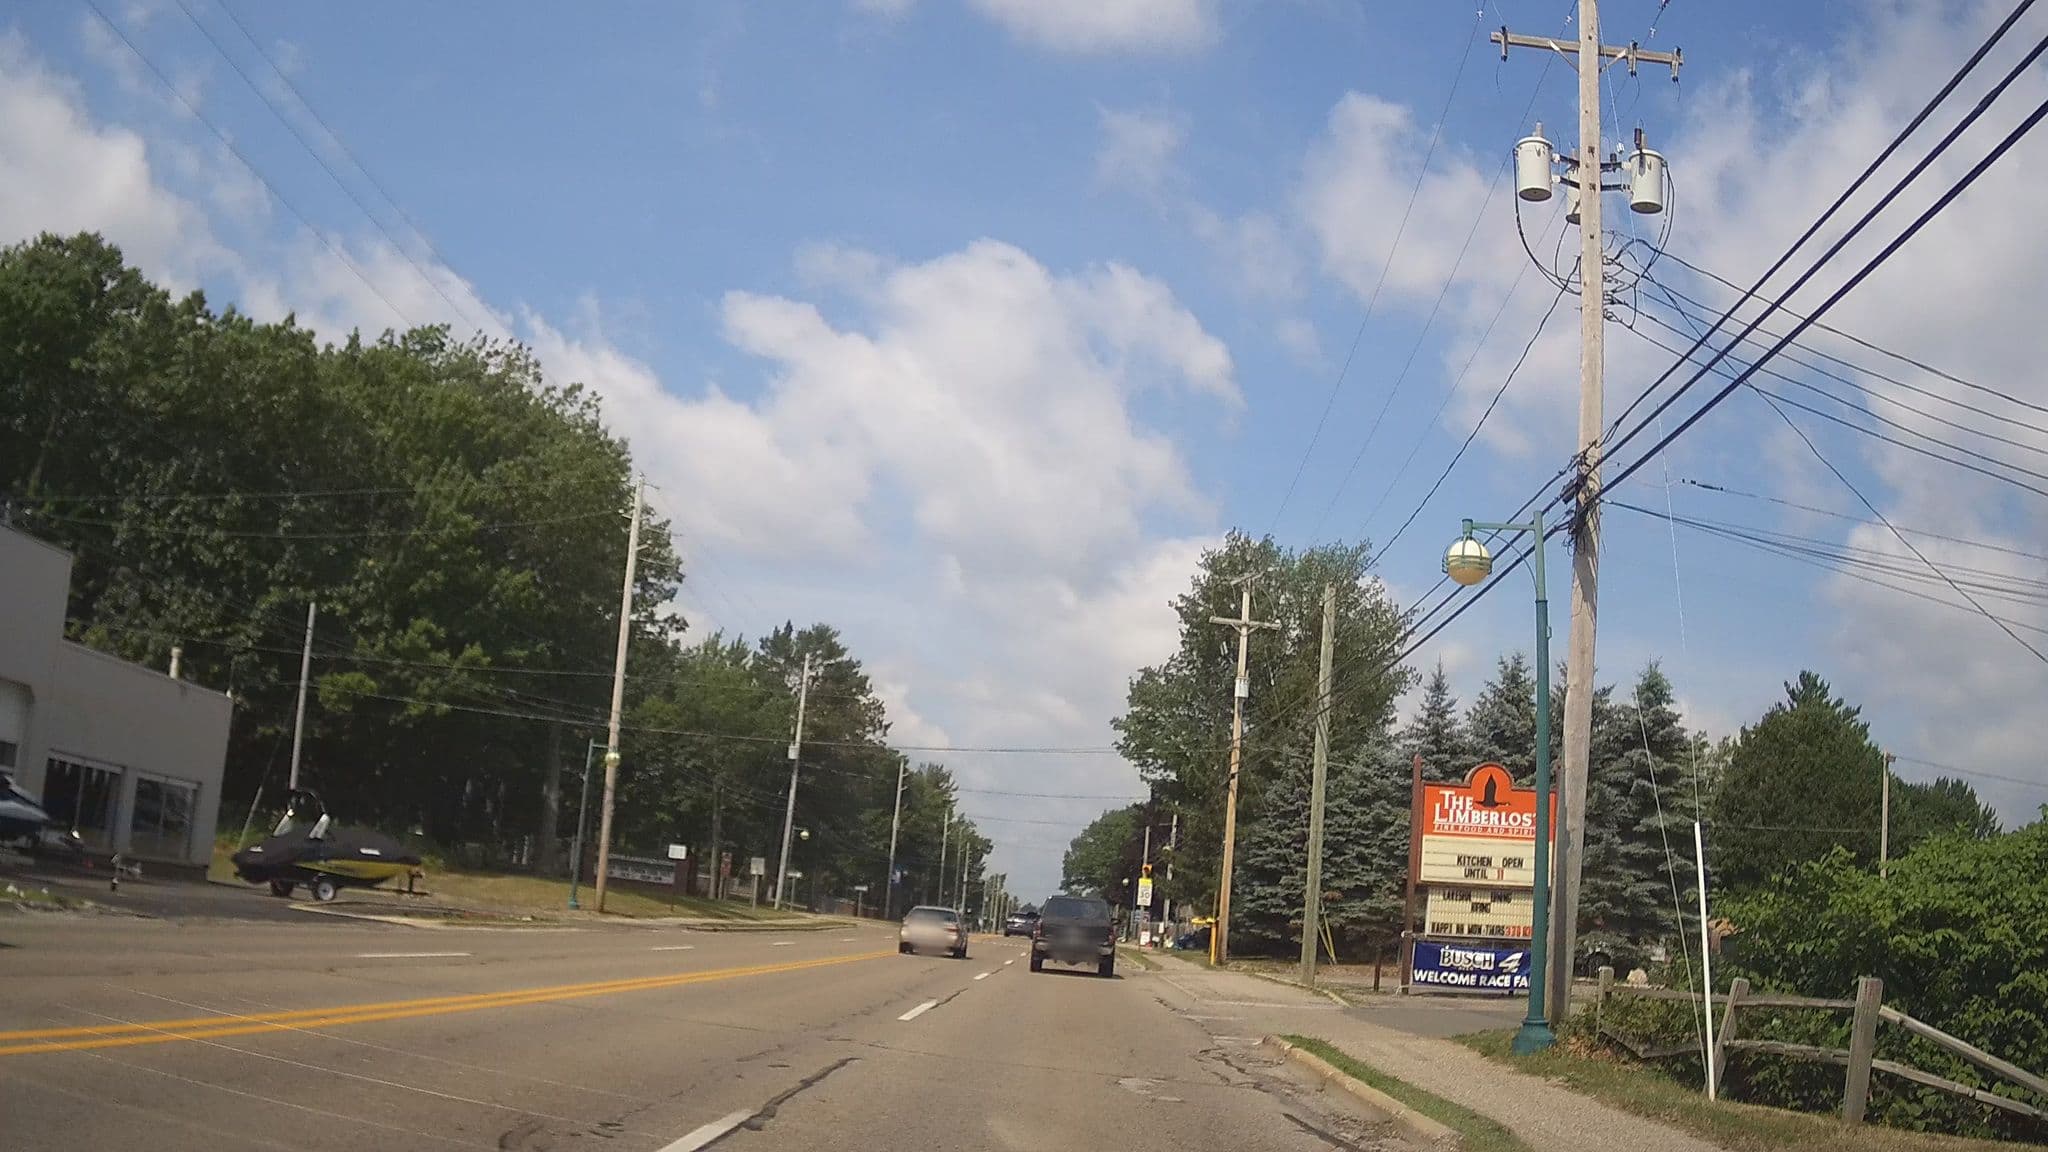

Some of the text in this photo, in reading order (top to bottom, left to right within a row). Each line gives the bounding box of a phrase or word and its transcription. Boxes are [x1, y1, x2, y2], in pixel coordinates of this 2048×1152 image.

[1439, 789, 1474, 811] THE
[1432, 802, 1536, 827] LIMBERLOS
[1434, 824, 1455, 832] FINE
[1459, 825, 1483, 833] FOOD
[1487, 827, 1505, 835] AND
[1456, 854, 1524, 869] KITCHEN OPEN
[1463, 868, 1488, 880] UNTIL
[1440, 948, 1495, 970] BUSCH
[1413, 969, 1476, 986] WELCOME
[1479, 975, 1511, 988] RACE
[1513, 976, 1530, 988] FA
